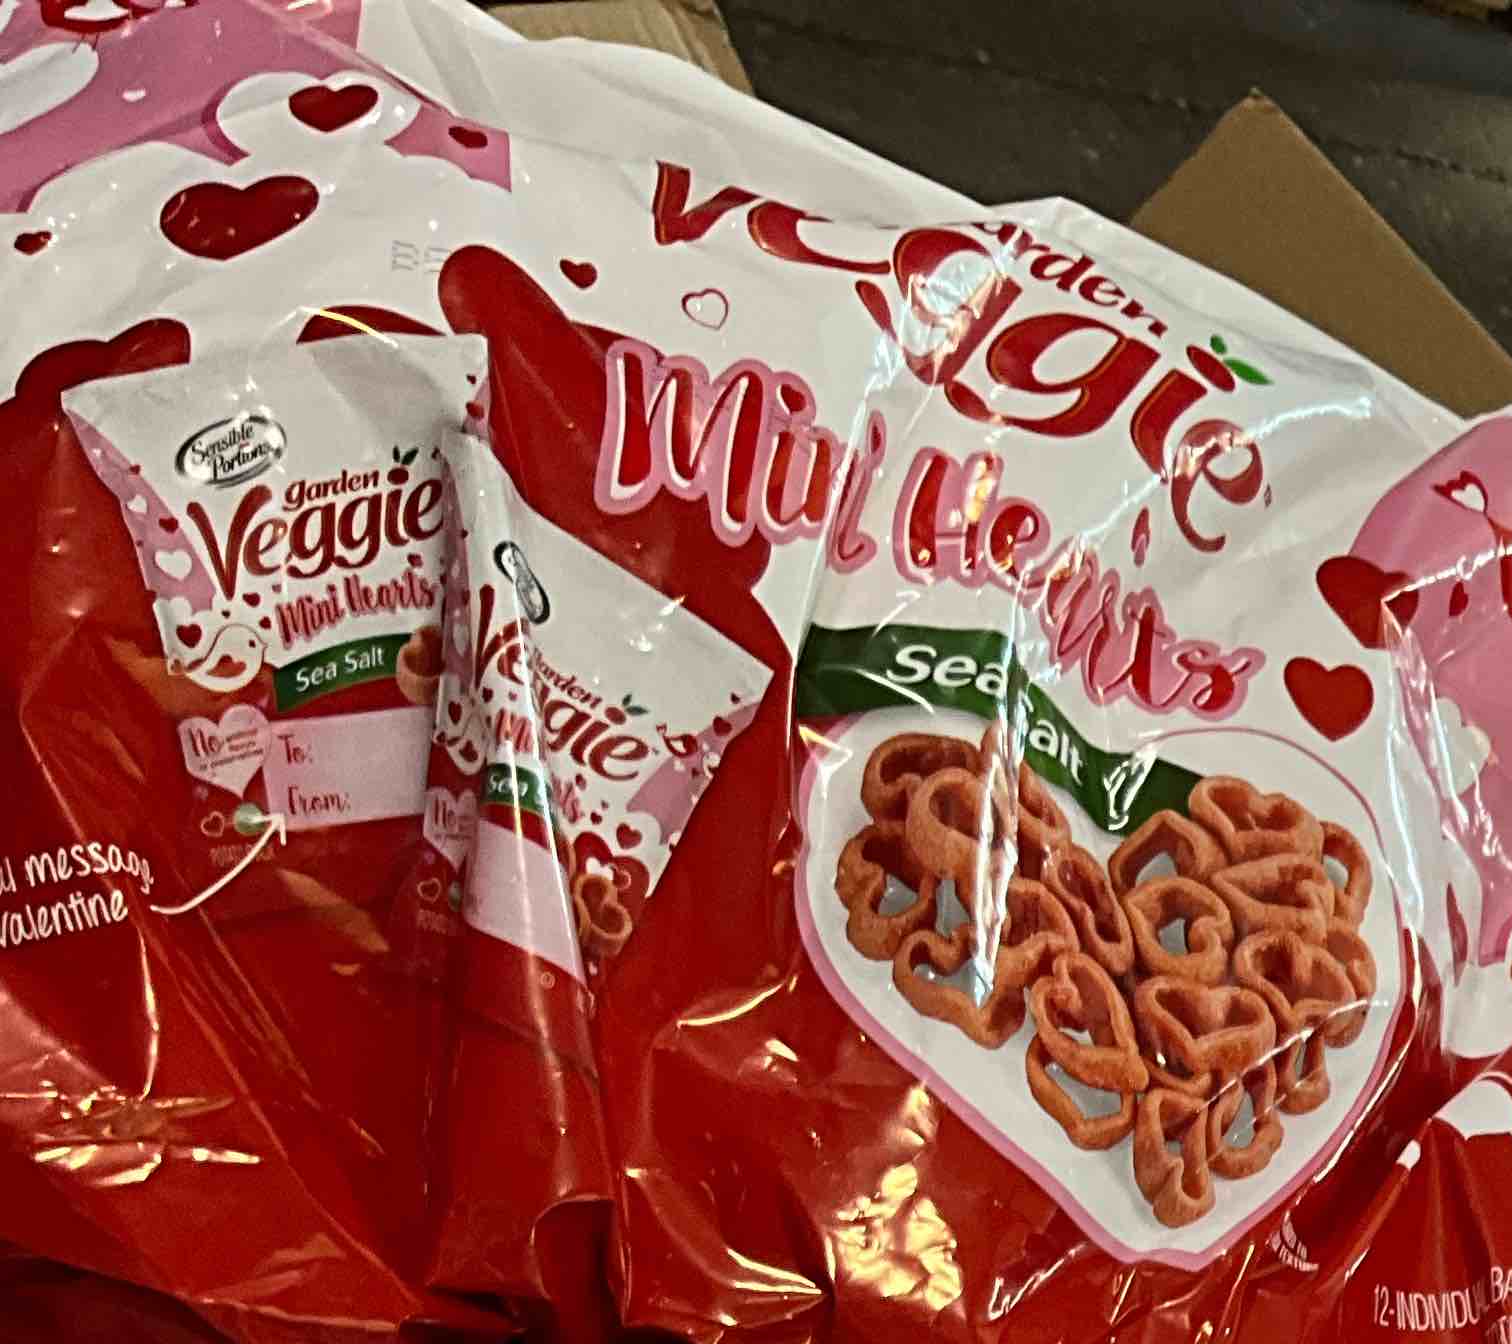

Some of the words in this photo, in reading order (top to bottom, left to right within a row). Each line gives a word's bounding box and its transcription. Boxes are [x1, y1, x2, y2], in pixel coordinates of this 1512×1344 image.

[192, 422, 255, 466] Sensible
[208, 443, 275, 482] Portions
[282, 469, 380, 511] garden
[186, 467, 445, 601] Veggie
[274, 584, 345, 650] Mini
[343, 569, 441, 615] Hearts
[295, 661, 338, 692] Sea
[343, 646, 386, 673] Salt
[885, 642, 1008, 696] Sea
